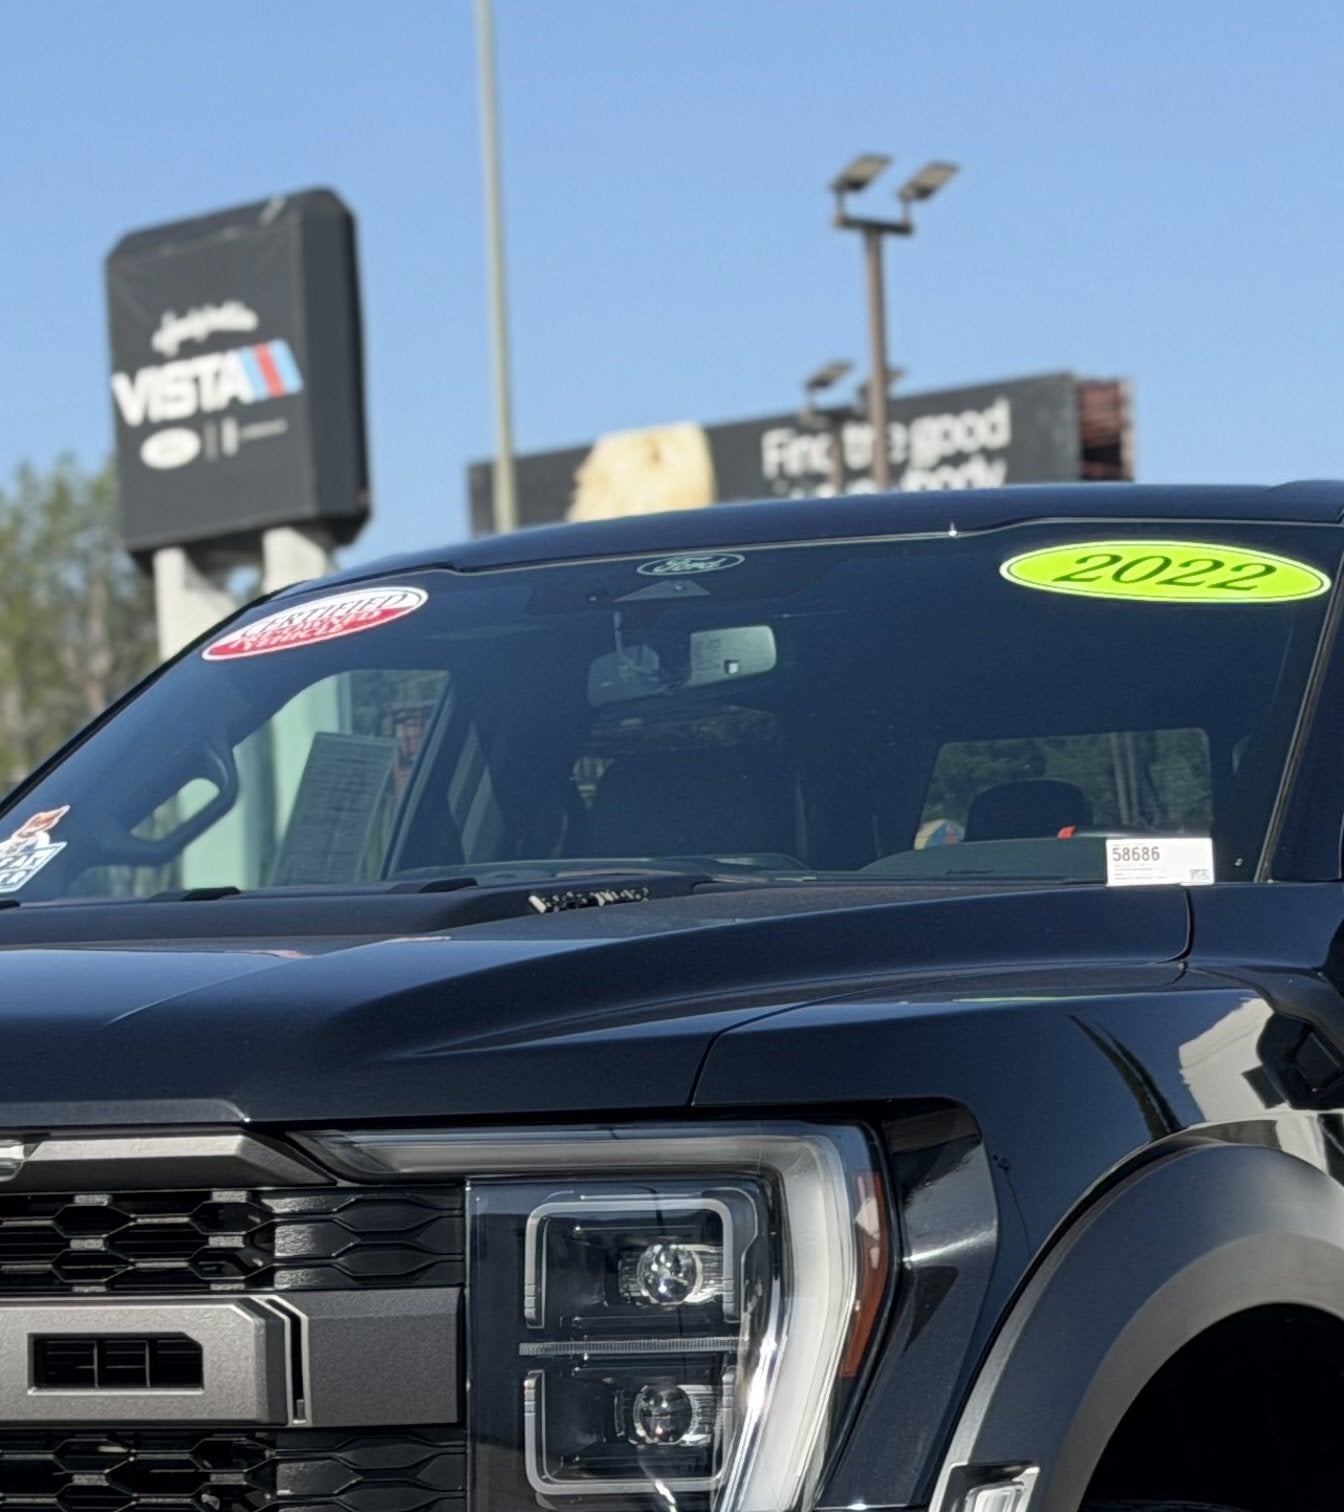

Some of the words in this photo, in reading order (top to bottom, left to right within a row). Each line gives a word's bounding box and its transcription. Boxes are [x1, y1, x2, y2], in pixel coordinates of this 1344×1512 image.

[112, 350, 255, 426] VISTA
[910, 398, 1010, 468] good
[652, 556, 728, 573] Ford
[1054, 553, 1277, 591] 2022
[241, 593, 408, 639] CERTIFIED
